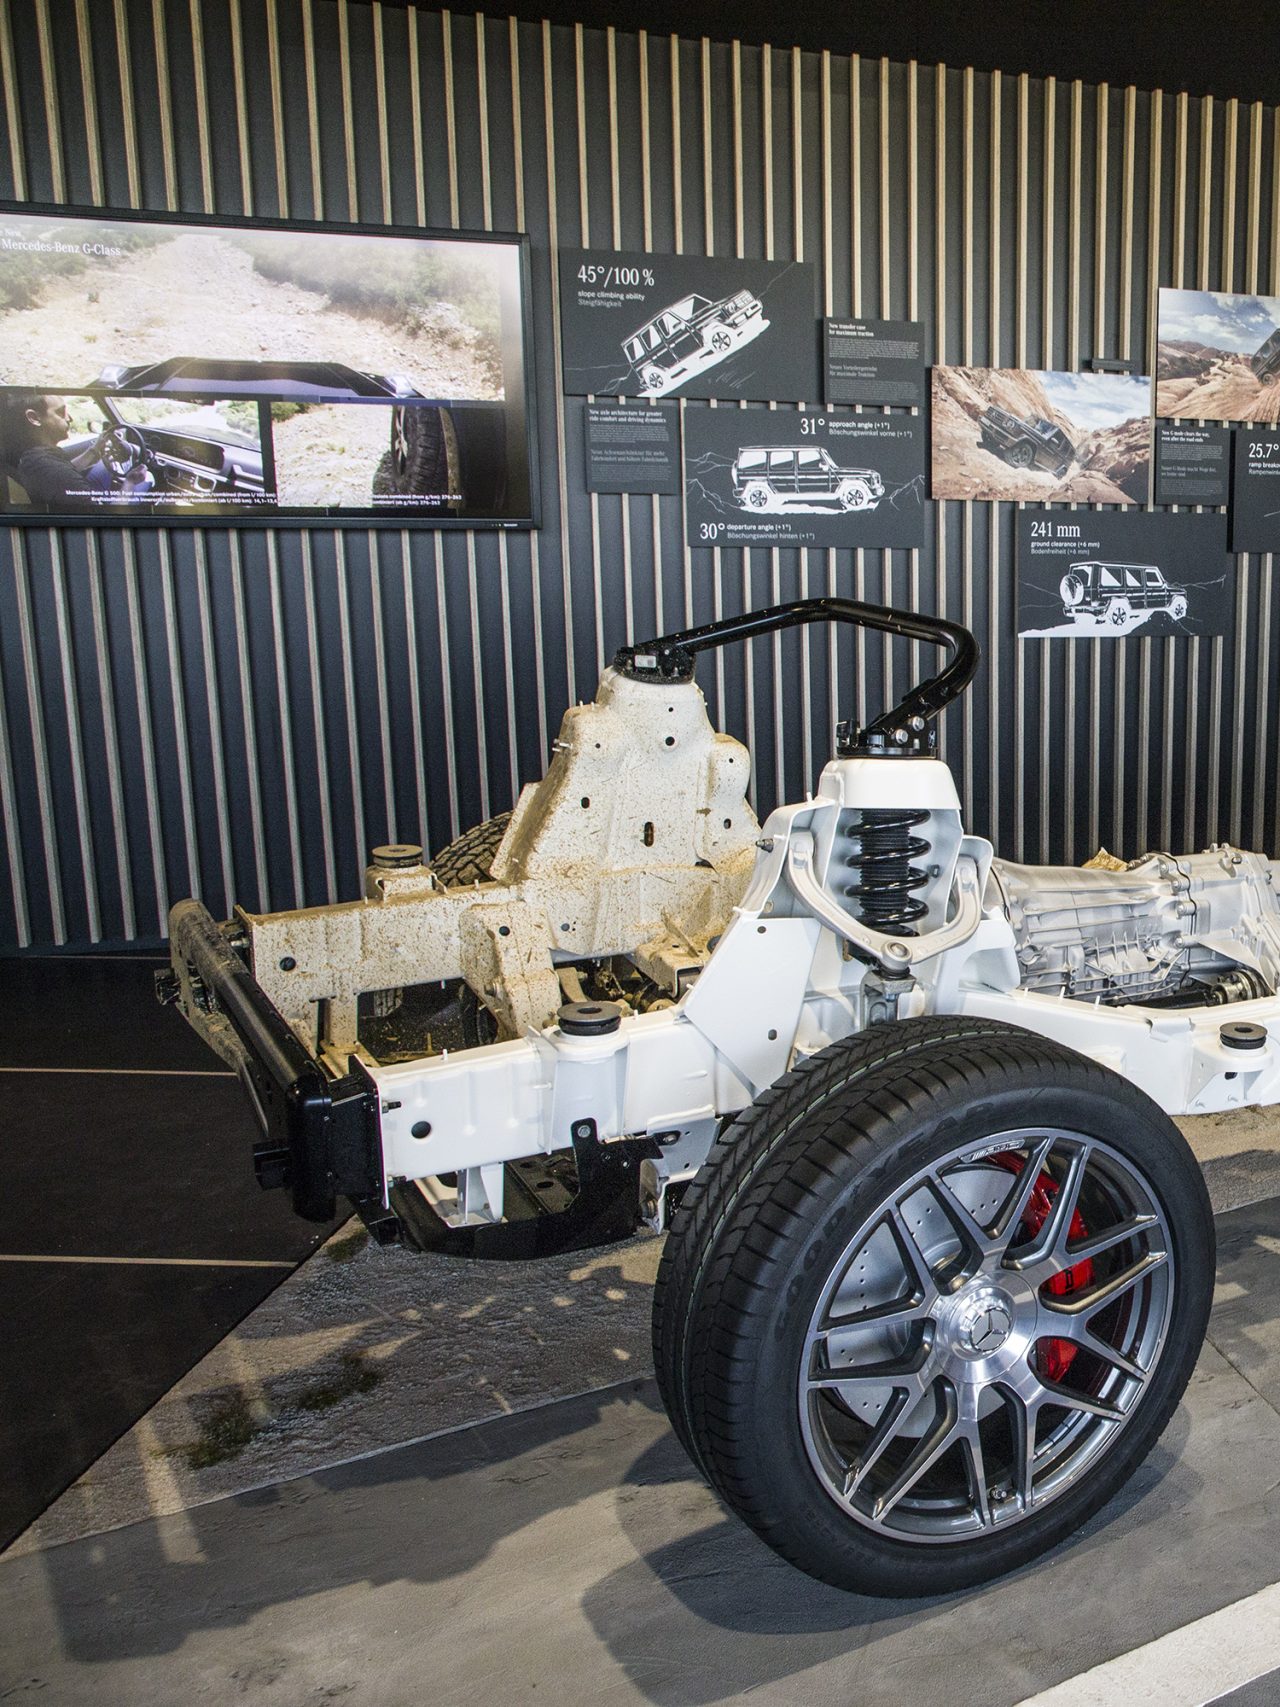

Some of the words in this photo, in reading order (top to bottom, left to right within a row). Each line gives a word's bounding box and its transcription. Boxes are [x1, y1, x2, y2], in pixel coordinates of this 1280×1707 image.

[1, 238, 80, 254] Mercedes-Benz
[82, 243, 121, 256] G-Class
[577, 264, 640, 289] 45°/100
[642, 268, 655, 287] %
[578, 290, 596, 299] slope
[597, 291, 625, 301] climbing
[625, 292, 645, 302] ability
[800, 418, 825, 435] 31°
[828, 420, 856, 429] approach
[857, 422, 873, 430] angle
[1248, 442, 1279, 458] 25.7°
[700, 523, 725, 539] 30°
[727, 523, 757, 532] departure
[757, 524, 774, 532] angle
[1030, 521, 1052, 537] 241
[1056, 525, 1081, 537] mm
[1087, 541, 1100, 549] mm)
